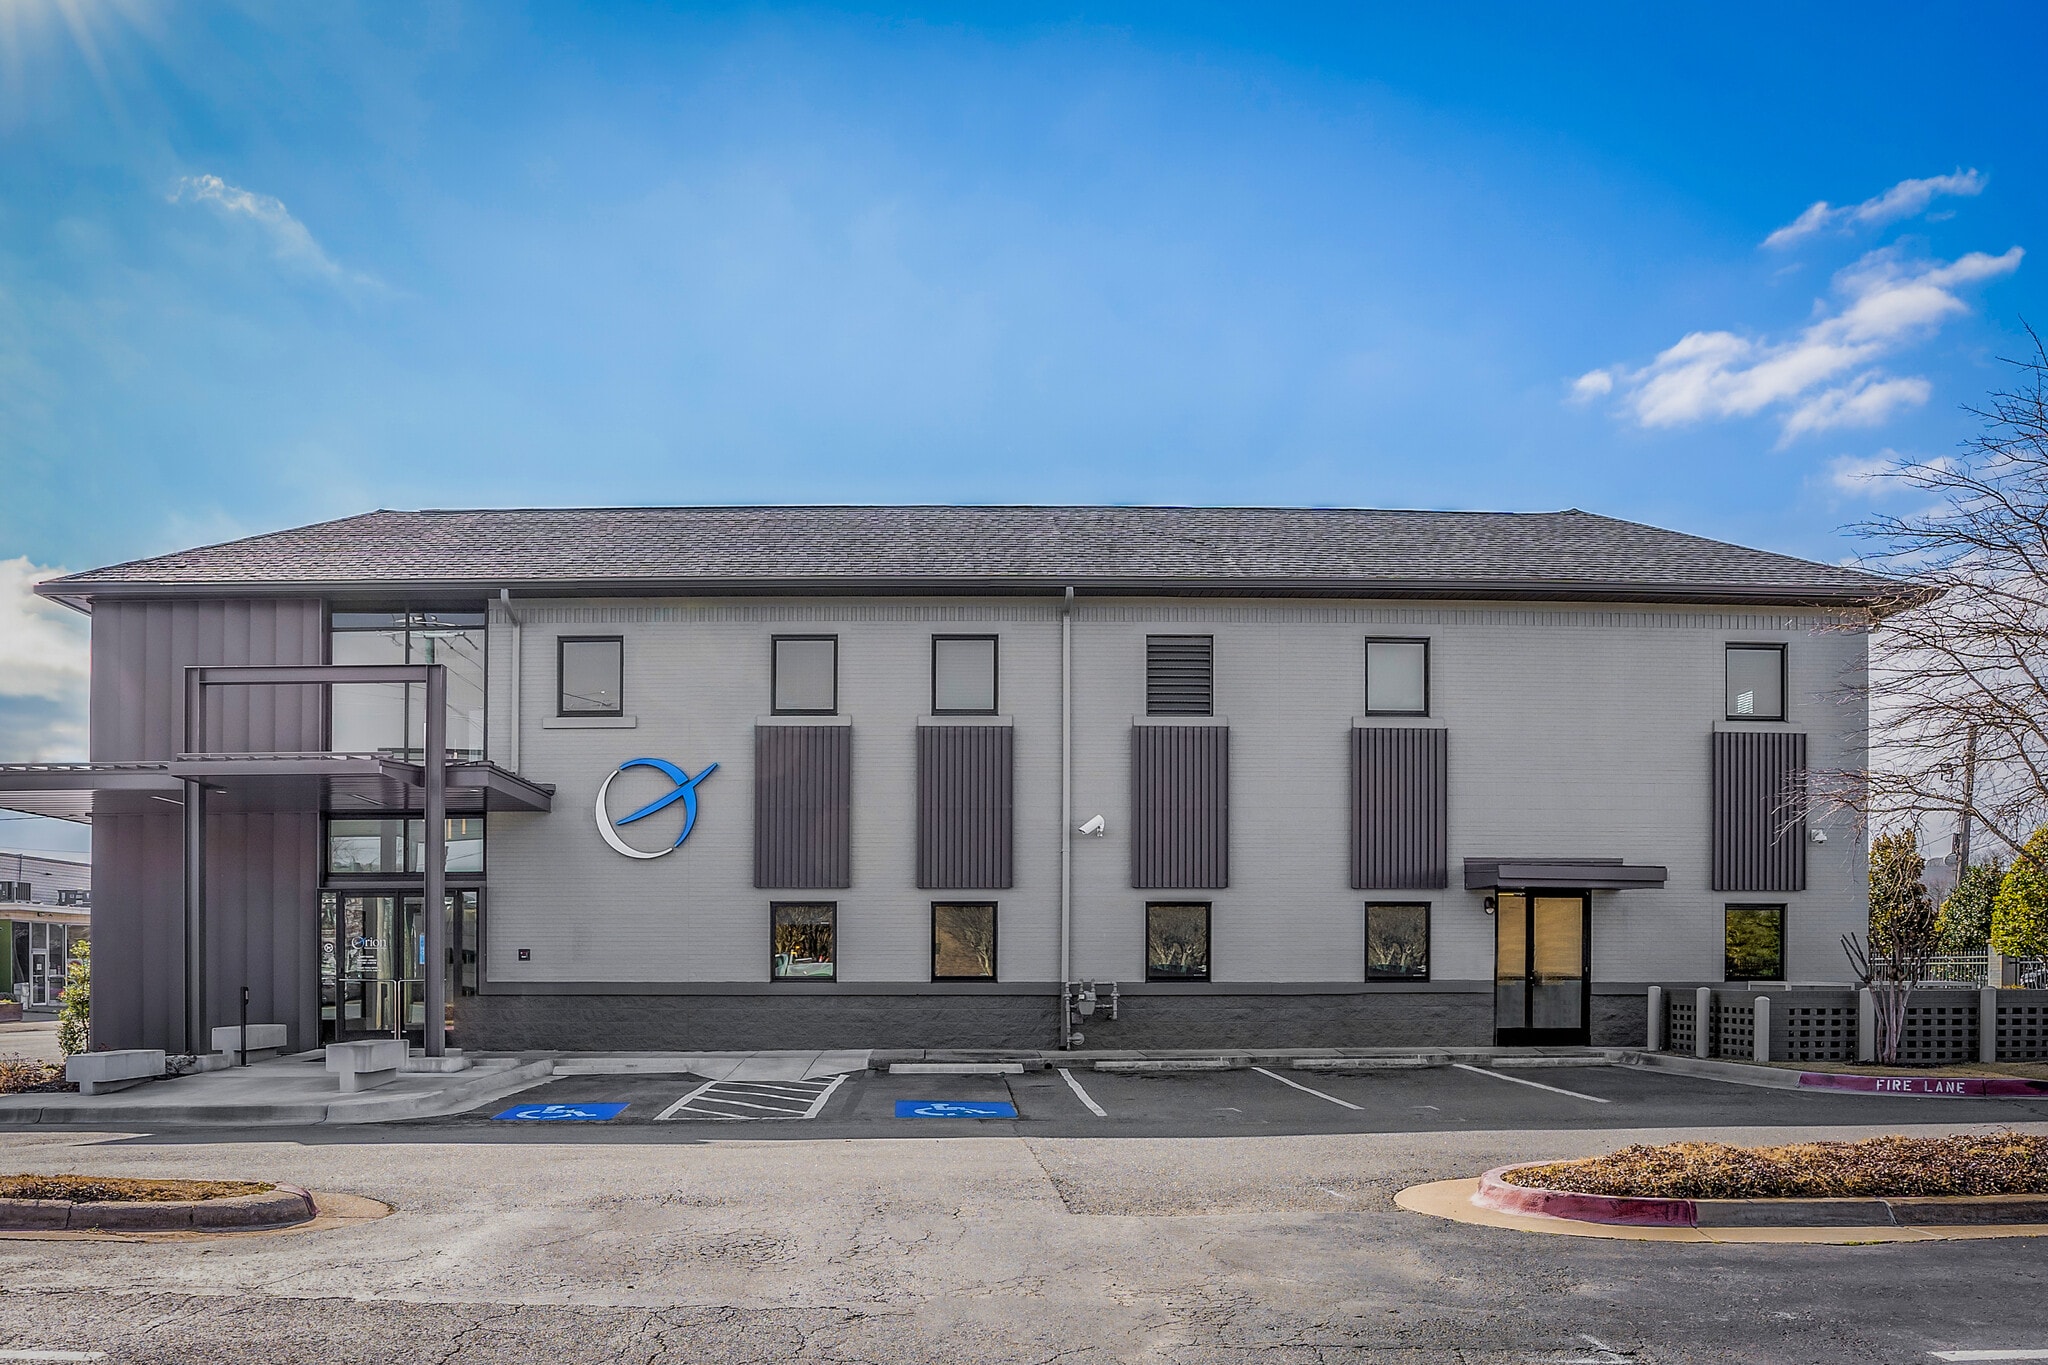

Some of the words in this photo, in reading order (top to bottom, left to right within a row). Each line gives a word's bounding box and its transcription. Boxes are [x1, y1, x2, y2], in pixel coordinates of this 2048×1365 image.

[352, 936, 387, 950] Orion
[1876, 1079, 1912, 1091] FIRE
[1924, 1080, 1965, 1094] LANE
